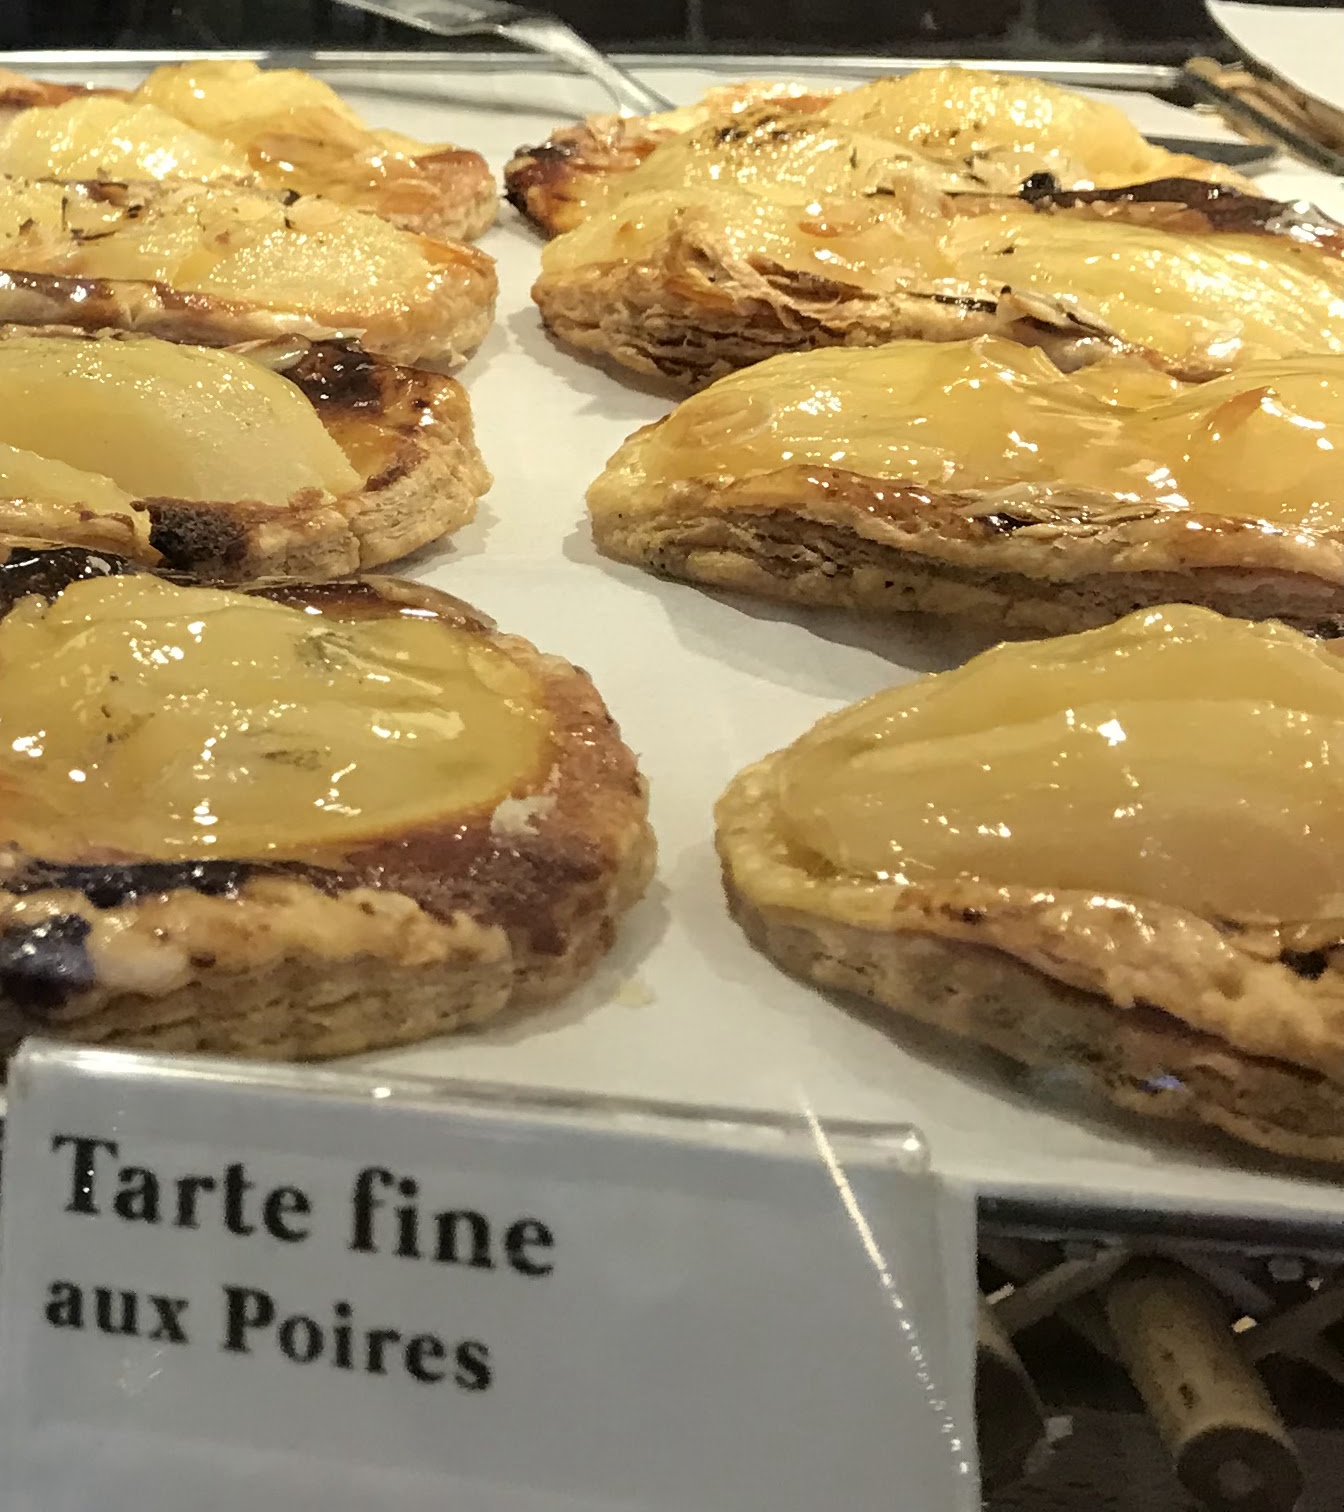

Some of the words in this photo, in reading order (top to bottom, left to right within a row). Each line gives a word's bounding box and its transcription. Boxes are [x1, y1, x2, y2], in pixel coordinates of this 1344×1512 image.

[51, 1133, 313, 1244] Tarte
[348, 1164, 558, 1278] fine
[43, 1279, 191, 1348] aux
[219, 1283, 495, 1395] Poires
